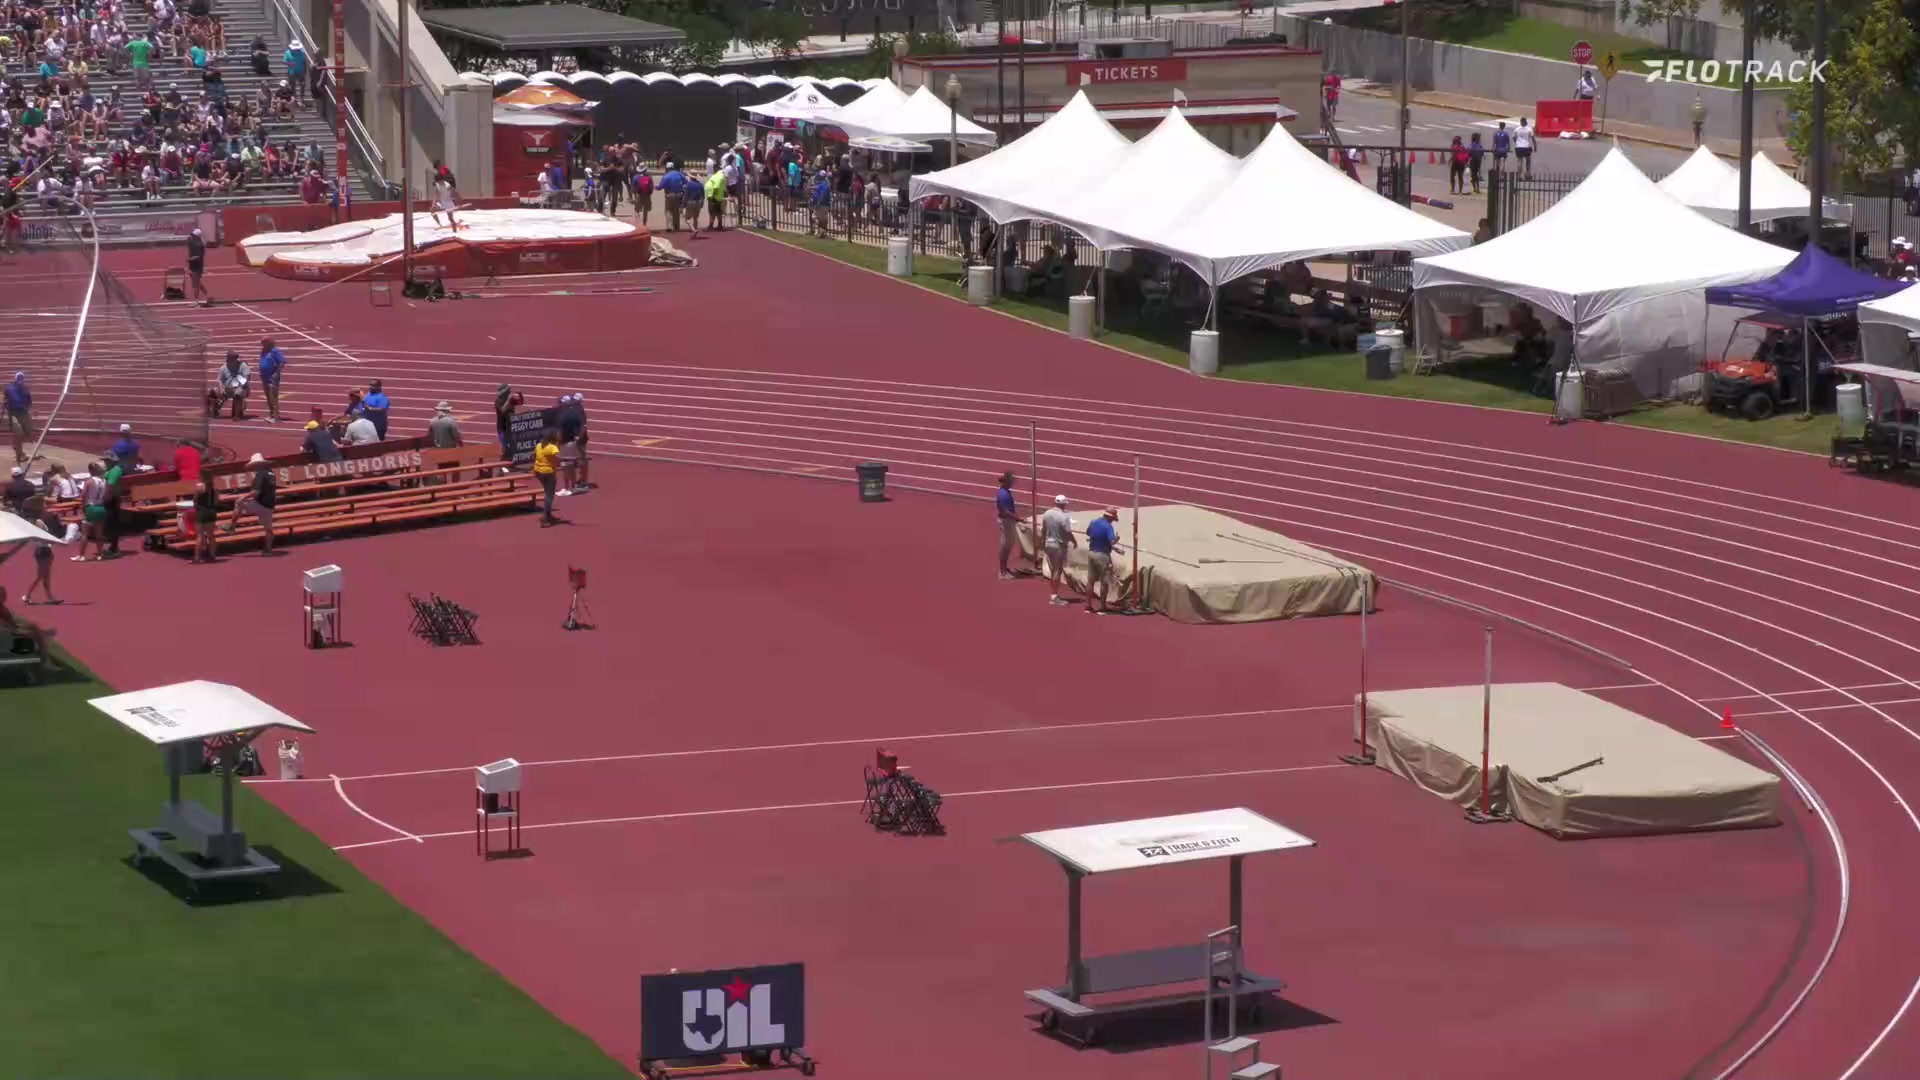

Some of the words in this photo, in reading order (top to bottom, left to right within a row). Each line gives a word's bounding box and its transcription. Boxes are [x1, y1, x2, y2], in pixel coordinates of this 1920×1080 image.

[1573, 48, 1591, 58] STOP
[1095, 65, 1158, 80] TICKETS
[219, 466, 292, 489] TES
[303, 451, 423, 479] LONGHORNS
[1167, 842, 1201, 852] TRACK
[1210, 836, 1241, 846] FIELD
